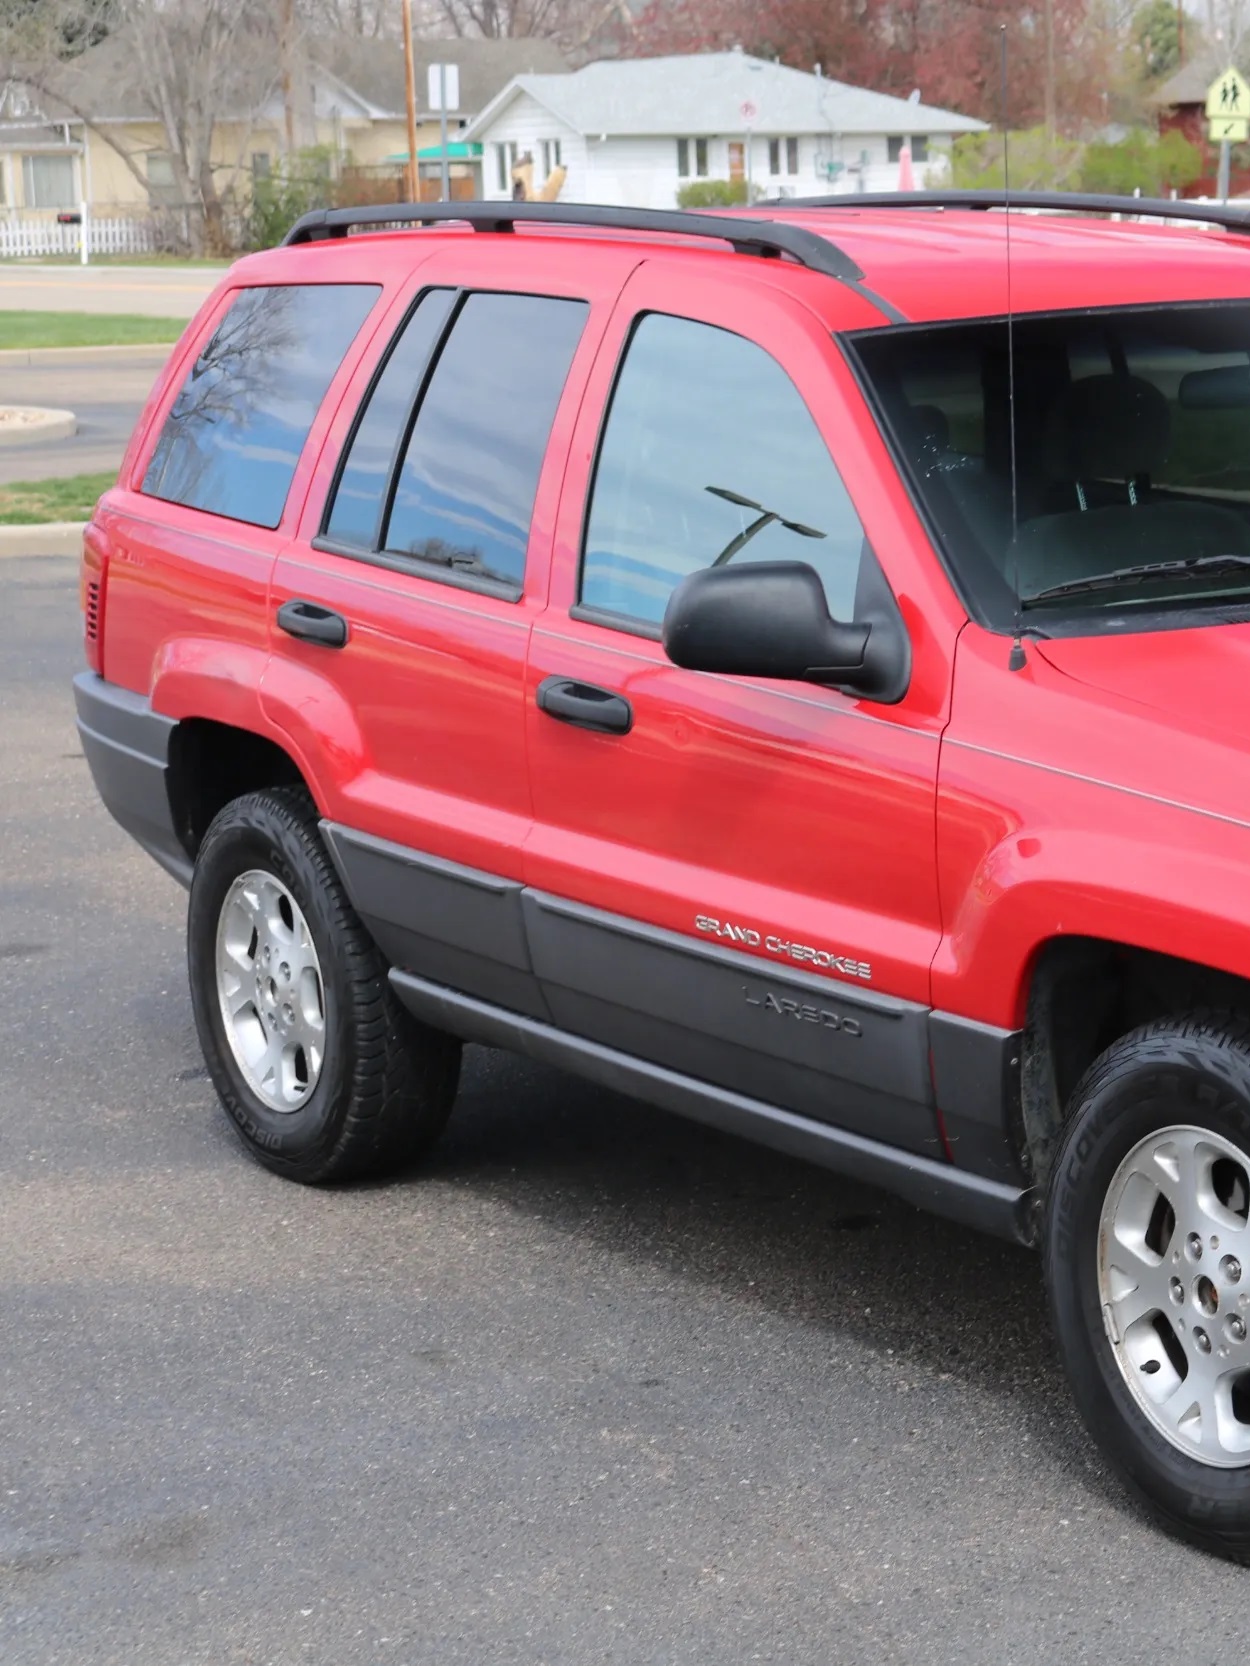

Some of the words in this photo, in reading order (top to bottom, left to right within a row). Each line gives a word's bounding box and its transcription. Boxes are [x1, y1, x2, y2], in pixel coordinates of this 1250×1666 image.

[695, 914, 761, 947] GRAND
[765, 935, 872, 980] CHEROKEE
[740, 985, 863, 1038] LAREDO
